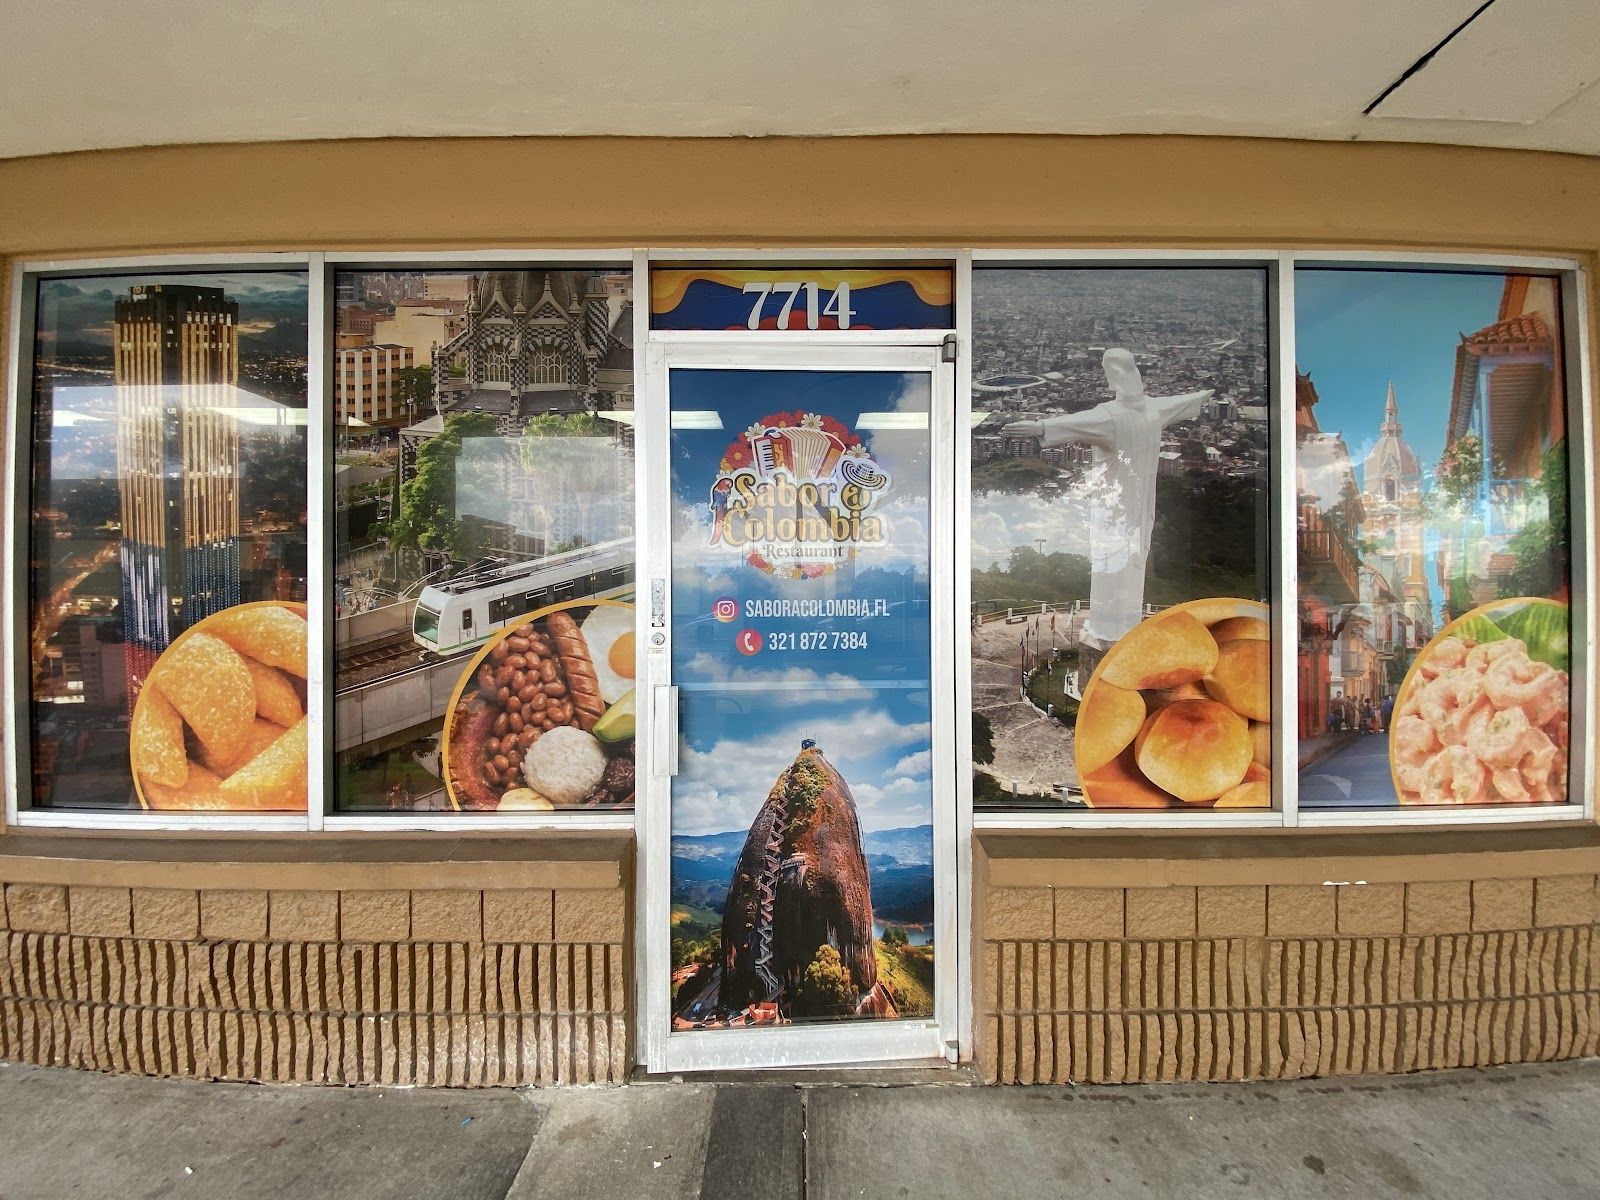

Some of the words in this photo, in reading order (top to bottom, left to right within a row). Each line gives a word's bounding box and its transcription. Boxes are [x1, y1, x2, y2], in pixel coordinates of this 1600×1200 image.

[742, 282, 856, 330] 7714
[734, 472, 837, 512] Sabor
[722, 506, 882, 546] Colombia
[763, 544, 843, 558] Restaurant
[745, 599, 890, 617] SABORACOLOMBIA.FL
[769, 632, 795, 650] 321
[800, 632, 828, 650] 872
[832, 631, 868, 650] 7384
